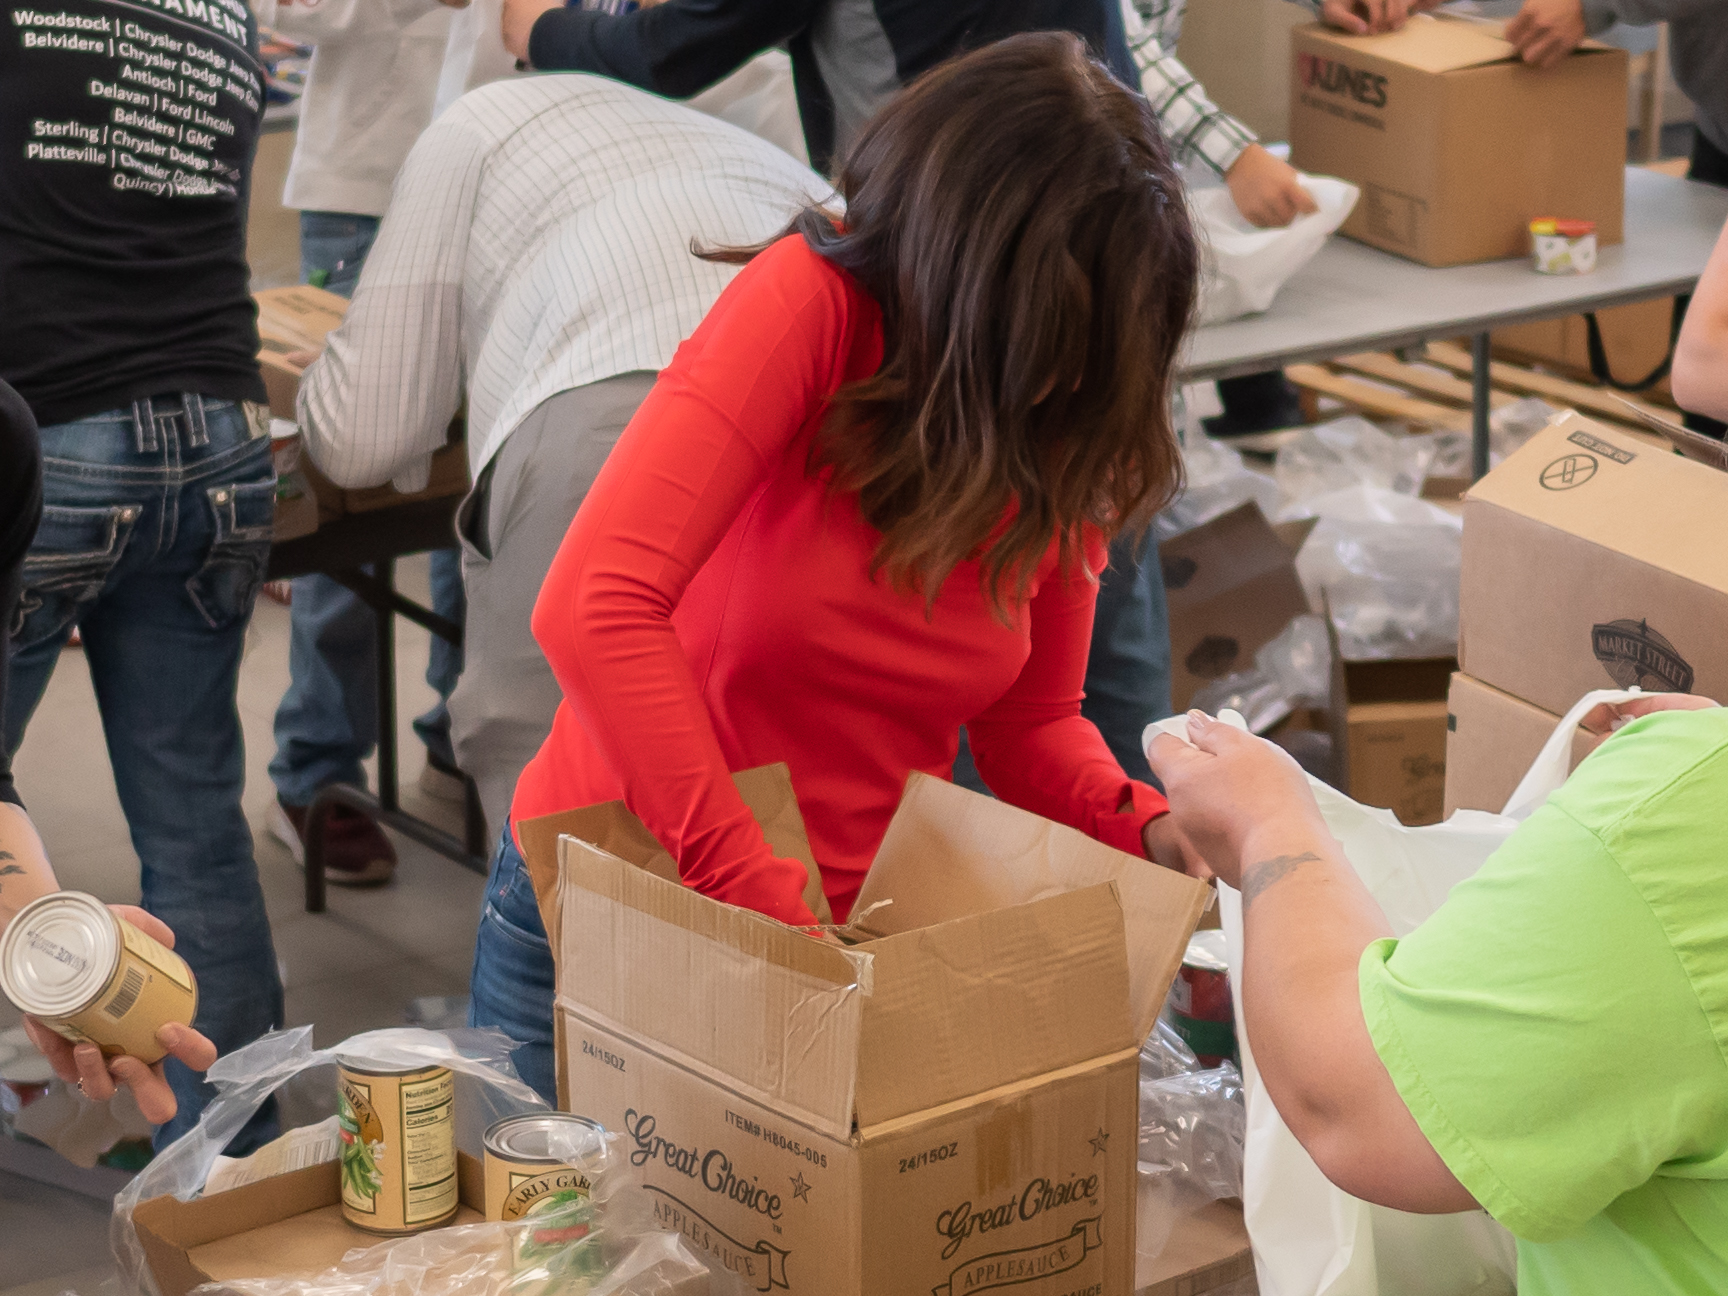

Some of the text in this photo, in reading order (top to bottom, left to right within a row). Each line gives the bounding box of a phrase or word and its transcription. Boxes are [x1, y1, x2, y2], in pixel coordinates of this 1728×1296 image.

[14, 10, 227, 69] Woodstock Chrysler Dodge
[24, 31, 223, 87] Belvidere Chrysler Dodge
[122, 64, 218, 105] Antioch Ford
[1309, 55, 1389, 109] KUNES
[90, 80, 235, 137] Delavan Ford Lincoln
[114, 107, 217, 151] Belvidere GMC
[26, 143, 107, 165] Platteville
[33, 119, 100, 144] Sterling
[112, 130, 168, 158] Chrysler
[113, 174, 166, 196] Quincy
[1597, 634, 1687, 686] MARKET STREET
[405, 1113, 439, 1127] Calories
[724, 1108, 761, 1138] ITEM#
[624, 1107, 783, 1220] Great Choice
[507, 1174, 591, 1216] EARLY GAR
[935, 1172, 1100, 1261] Great Choice
[963, 1244, 1071, 1289] APPLESAUCE
